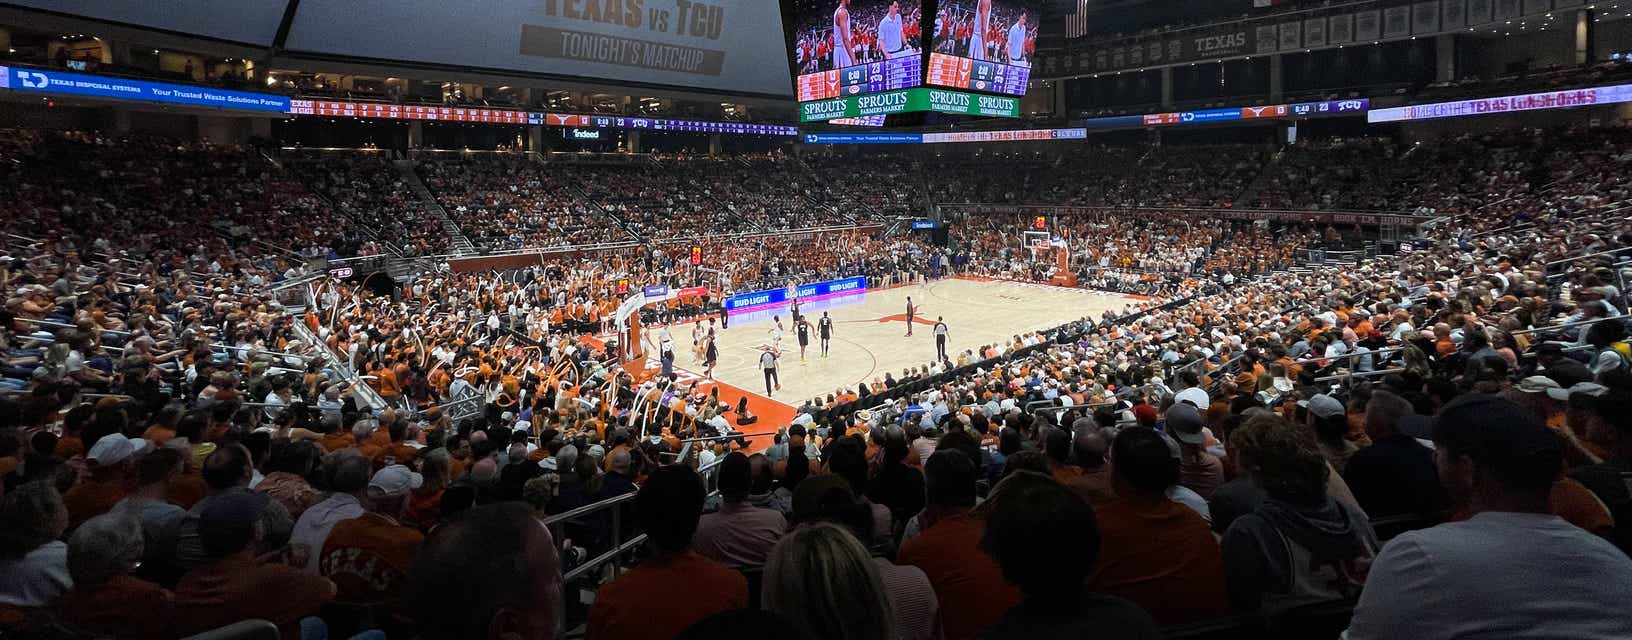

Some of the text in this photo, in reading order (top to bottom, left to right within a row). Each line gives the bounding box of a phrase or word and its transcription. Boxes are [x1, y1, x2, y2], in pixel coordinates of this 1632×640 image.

[677, 1, 723, 40] TCU
[1195, 32, 1246, 52] TEXAS
[561, 32, 704, 71] TONIGHT'S MATCHUP
[872, 63, 881, 74] 23
[50, 78, 75, 87] TEXAS
[75, 81, 111, 90] DISPOSAL
[112, 84, 141, 93] SYSTEMS
[152, 87, 284, 107] Your Trusted Waste Solutions Partner
[858, 92, 908, 109] SPROUTS
[929, 90, 970, 106] SPROUTS
[978, 95, 1014, 110] SPROUTS
[804, 98, 848, 115] SPROUTS
[860, 103, 905, 115] FARMERS MARKET
[1319, 103, 1328, 111] 23
[1337, 100, 1361, 111] TCU
[1469, 98, 1508, 113] TEXAS
[806, 111, 845, 120] FARMERS MARKET
[632, 119, 648, 128] TCU
[597, 247, 636, 258] WELCOME
[798, 287, 817, 298] LIGHT
[829, 281, 858, 292] BUD LIGHT
[734, 295, 769, 307] BUD LIGHT
